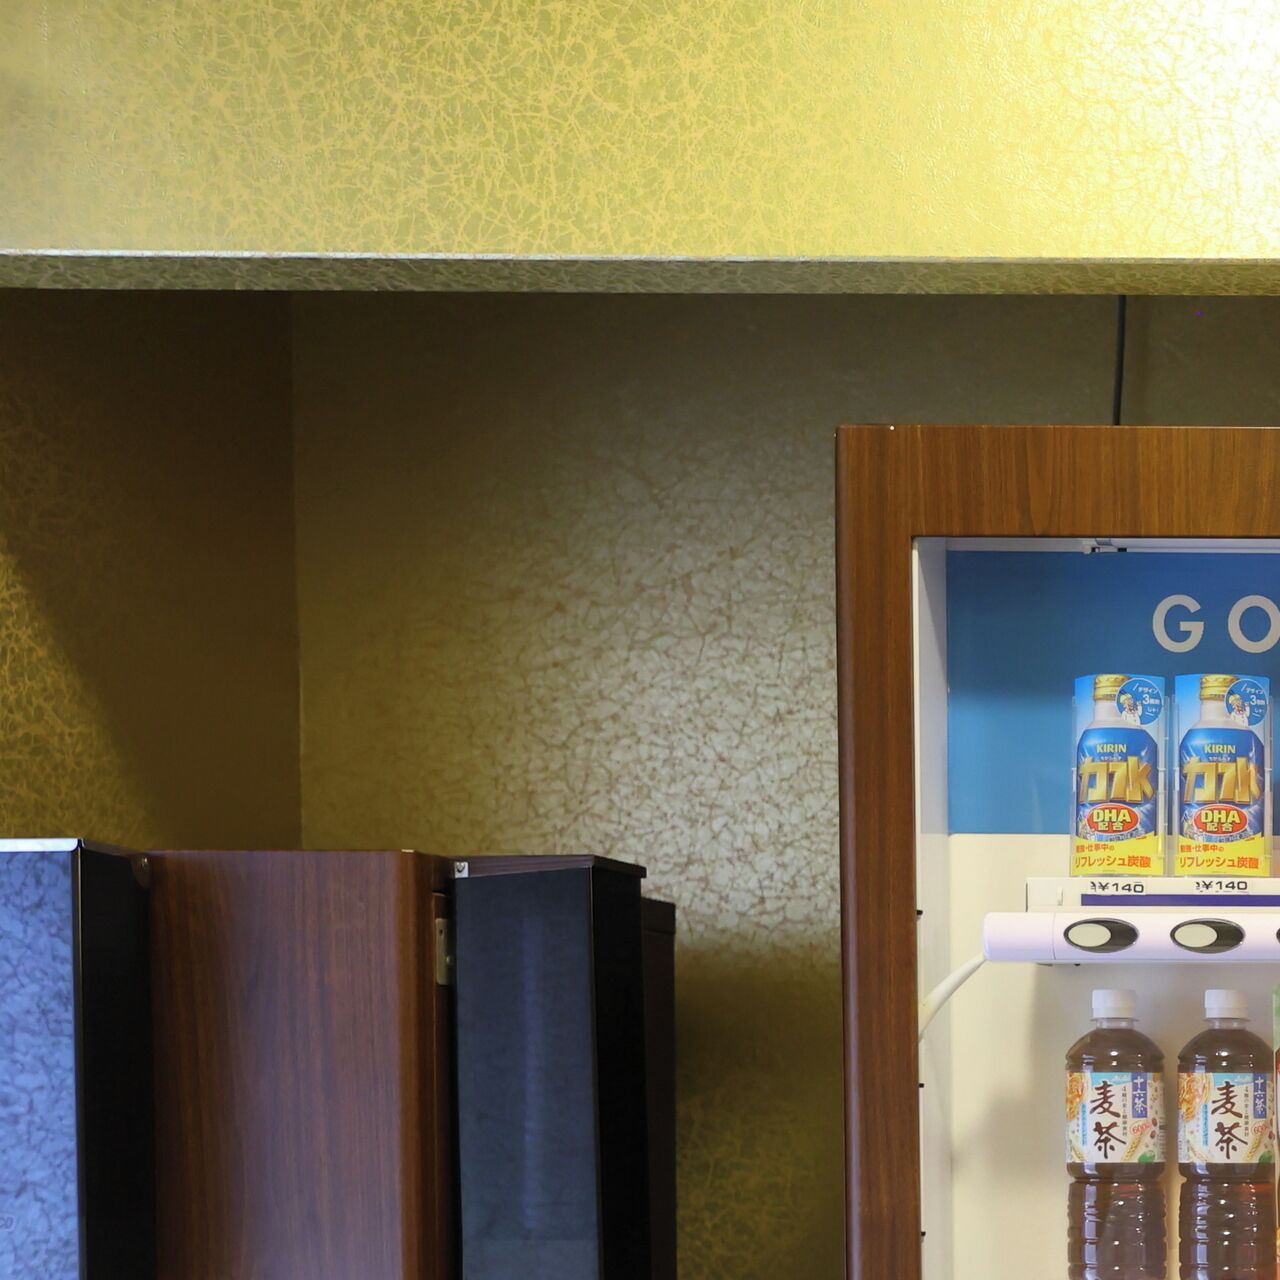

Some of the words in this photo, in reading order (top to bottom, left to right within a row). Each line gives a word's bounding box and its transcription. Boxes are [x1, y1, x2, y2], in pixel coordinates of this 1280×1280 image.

[1093, 809, 1132, 822] DHA
[1201, 809, 1240, 822] DHA
[1090, 1081, 1127, 1159] 麦茶
[1211, 1081, 1248, 1160] 麦茶
